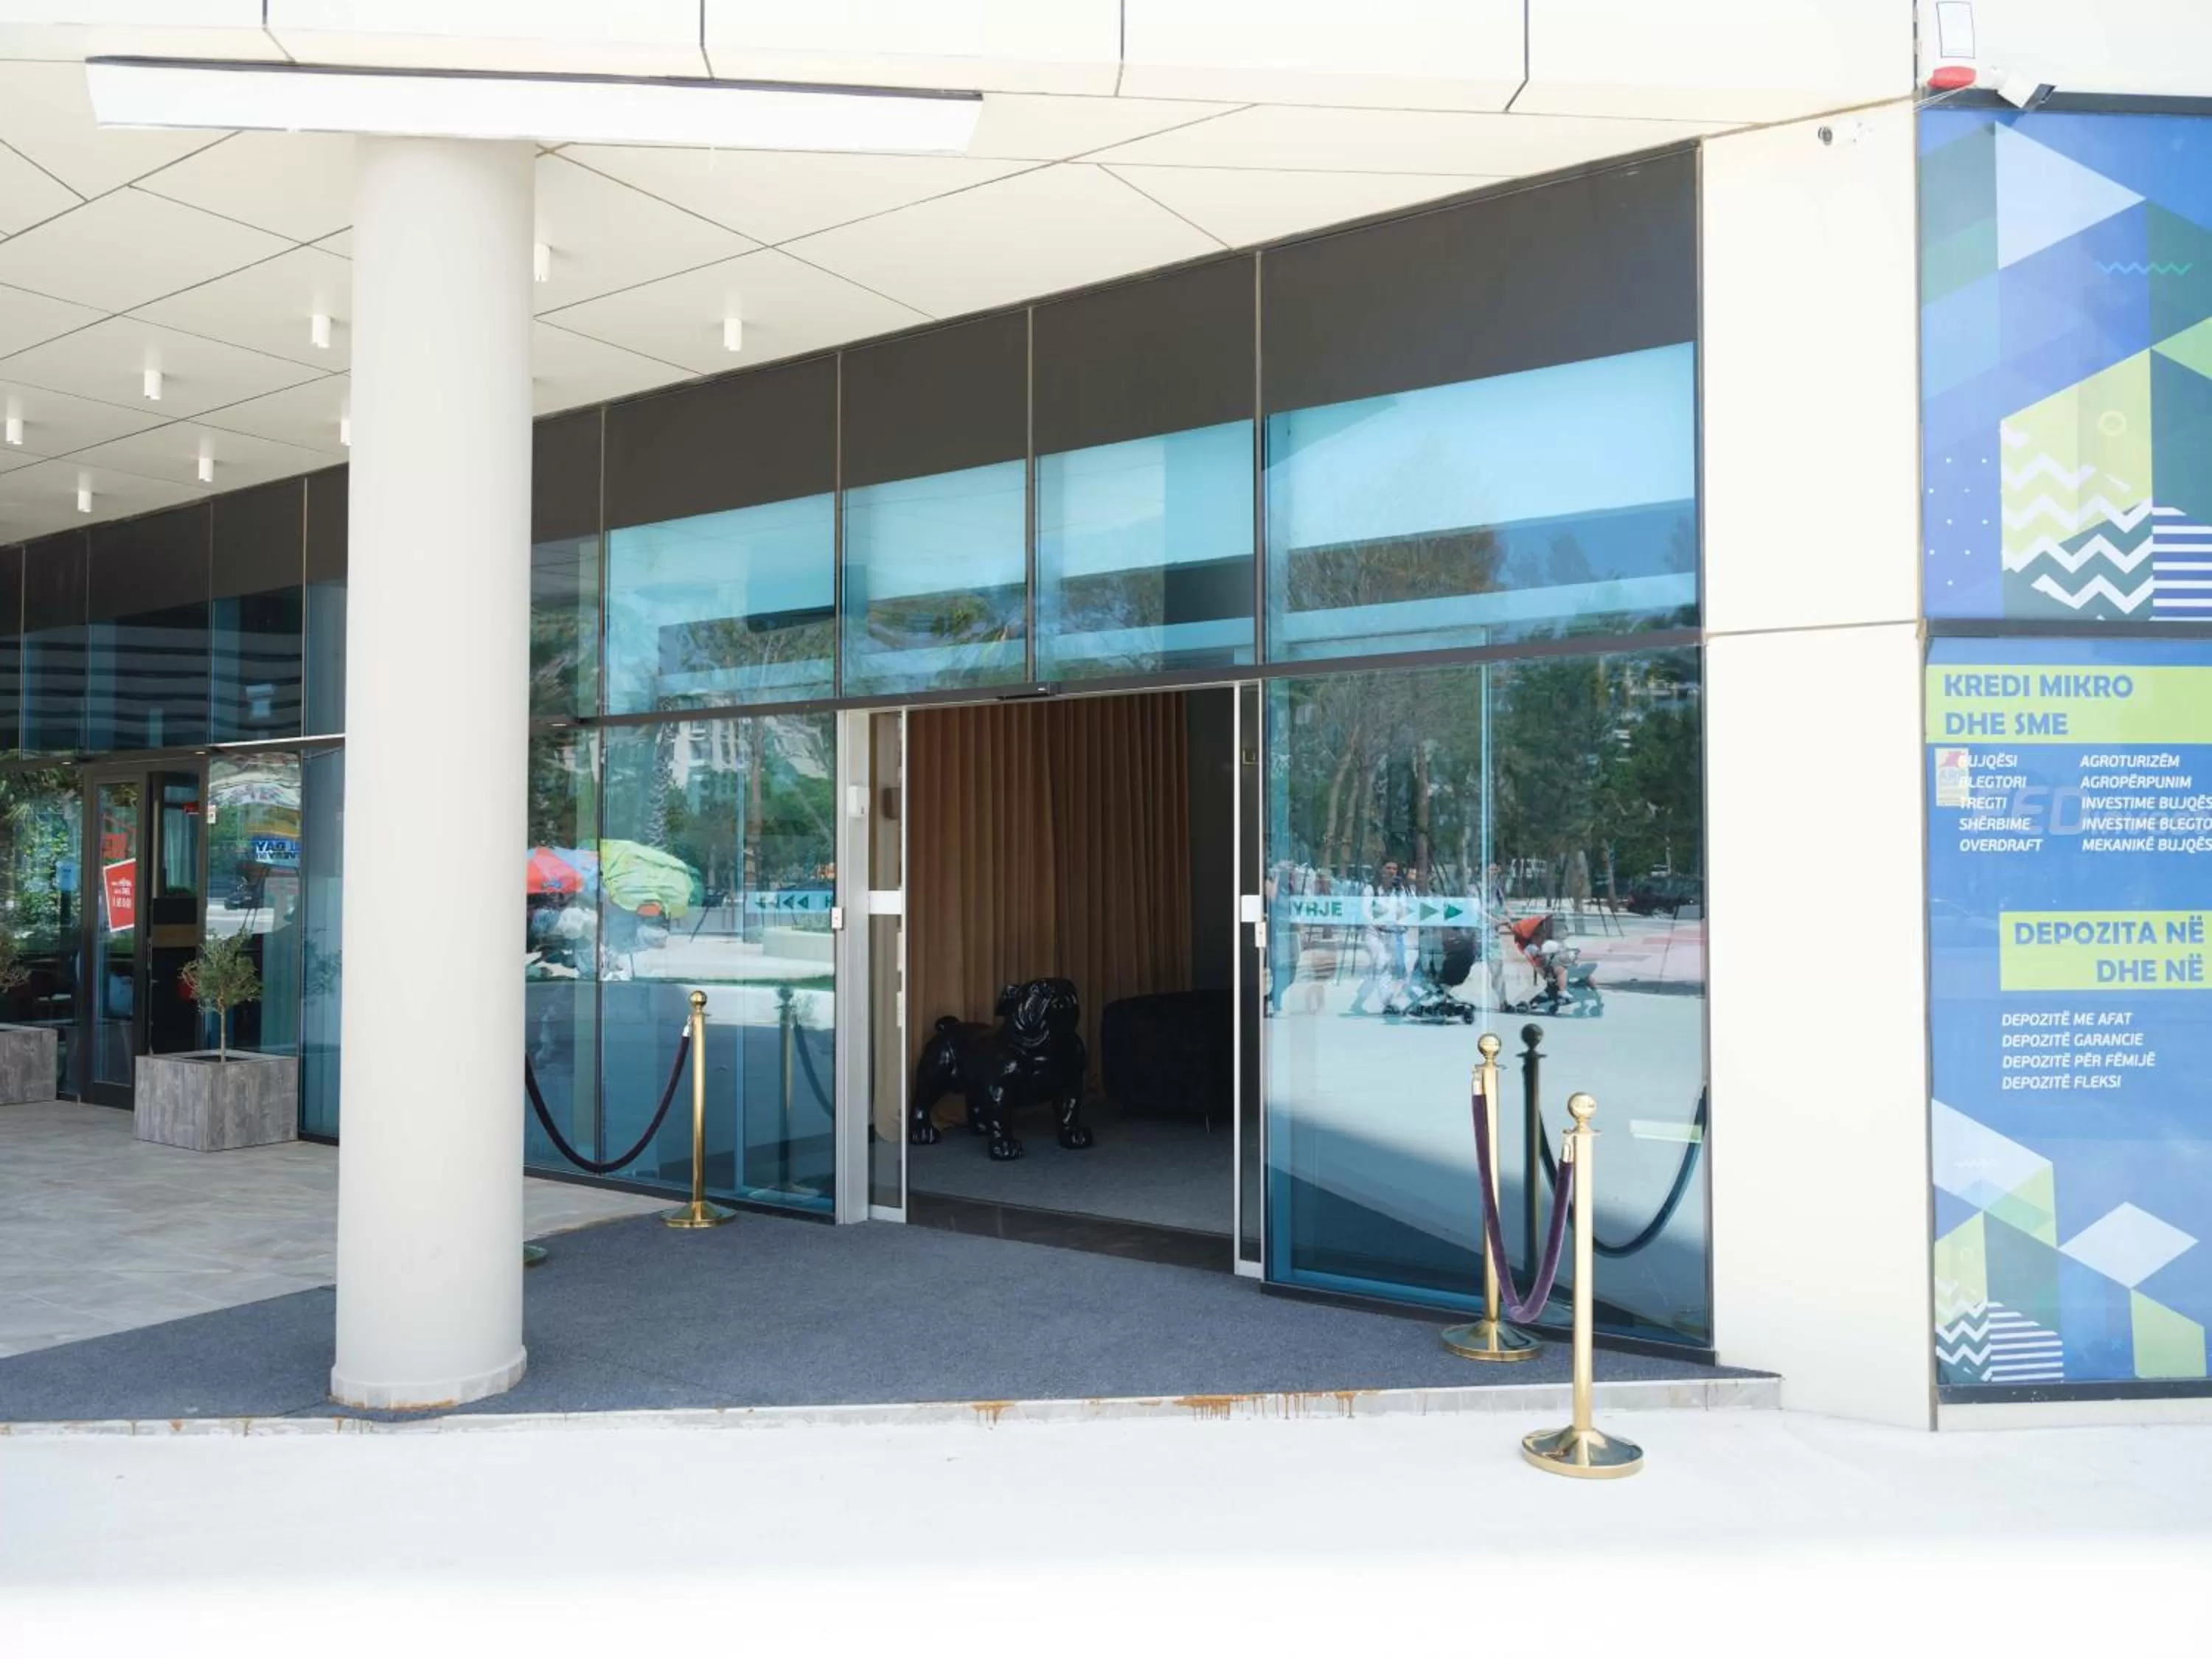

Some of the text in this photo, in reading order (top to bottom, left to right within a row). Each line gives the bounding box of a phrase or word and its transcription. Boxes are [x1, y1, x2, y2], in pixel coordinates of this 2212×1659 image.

[1944, 674, 2134, 698] KREDI MIKRO
[1945, 712, 2069, 736] DHE SME
[2080, 753, 2180, 768] AGROTURIZËM
[2080, 773, 2192, 790] AGROPËRPUNIM
[2081, 796, 2155, 810] INVESTIME
[1958, 815, 2031, 831] SHËRBIME
[2081, 817, 2155, 831] INVESTIME
[1960, 838, 2043, 852] OVERDRAFT
[2082, 836, 2154, 852] MEKANIKË
[2014, 915, 2204, 945] DEPOZITA NË
[2096, 953, 2204, 983] DHE NË
[2002, 1010, 2133, 1026] DEPOZITË ME AFAT
[2002, 1032, 2144, 1048] DEPOZITË GARANCIE
[2003, 1051, 2157, 1068] DEPOZITË PËR FËMIJË
[2002, 1074, 2122, 1090] DEPOZITË FLEKSI
